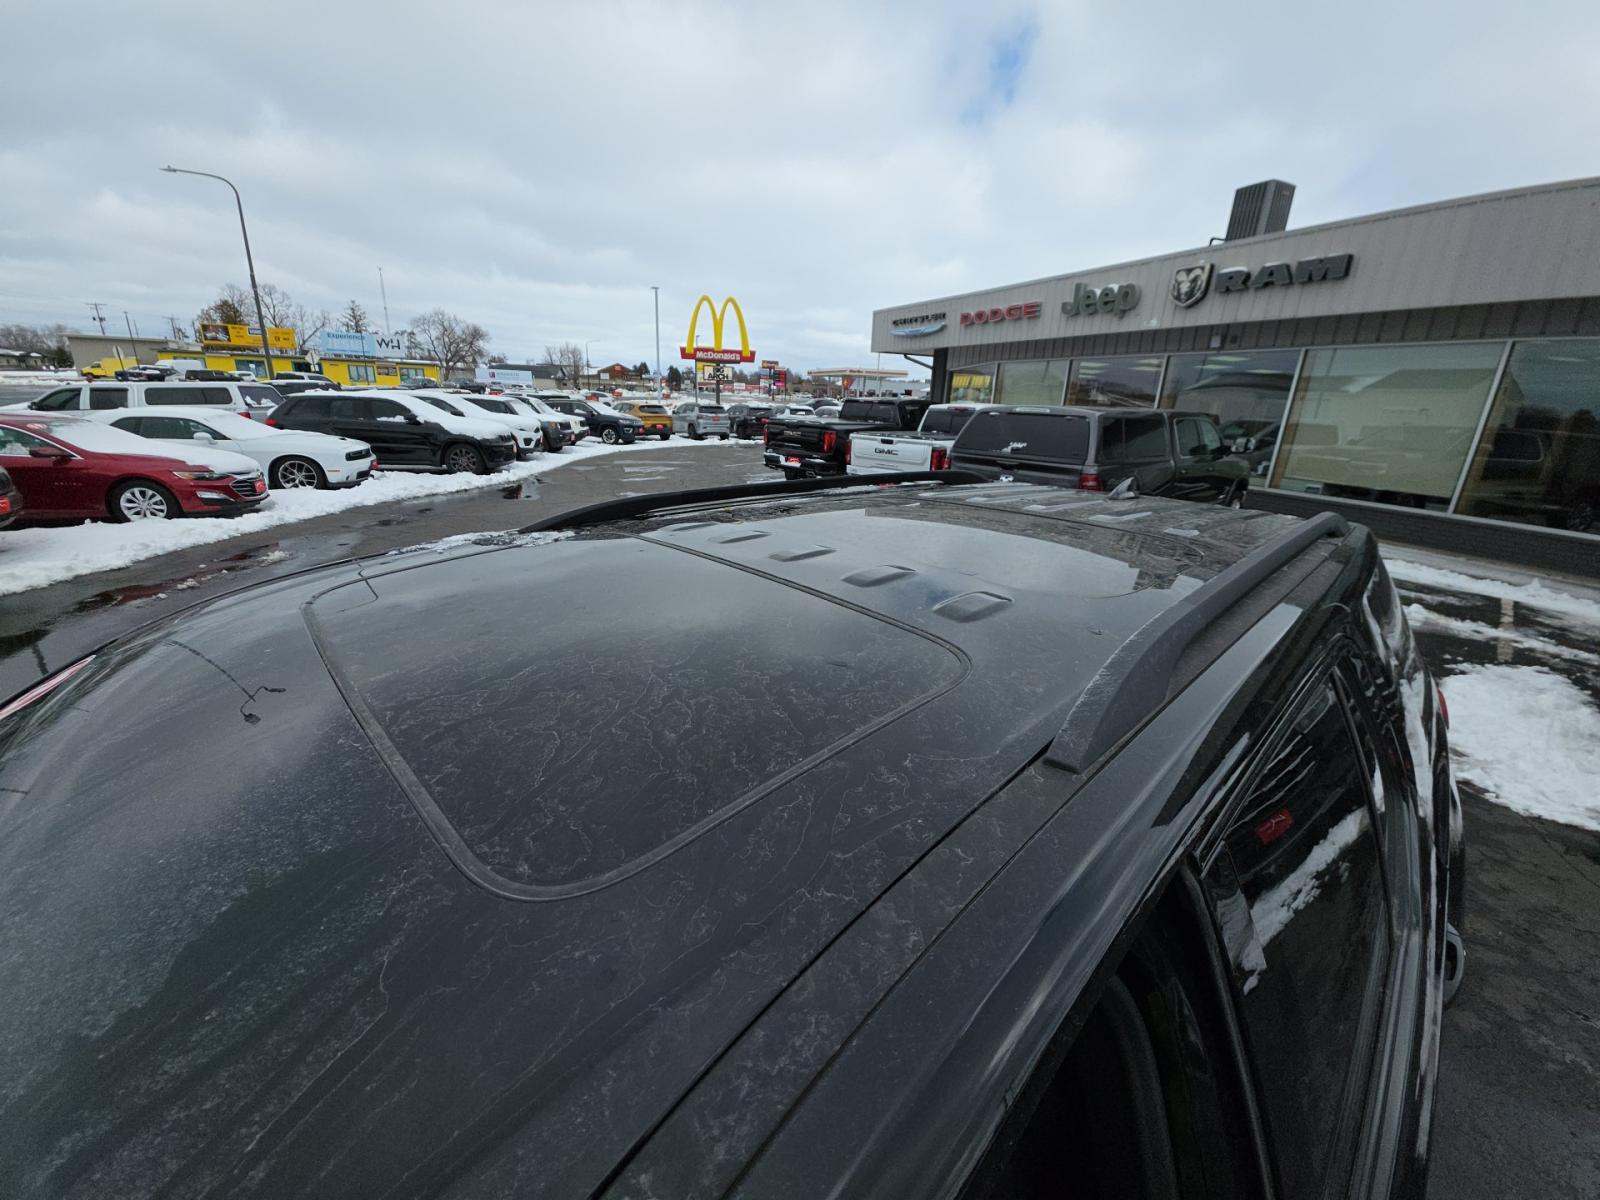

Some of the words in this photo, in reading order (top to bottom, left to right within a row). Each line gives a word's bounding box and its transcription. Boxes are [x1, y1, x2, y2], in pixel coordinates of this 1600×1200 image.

[1215, 254, 1353, 292] RAM
[1061, 282, 1142, 319] Jeep
[960, 301, 1041, 327] DODGE
[696, 351, 740, 360] McDonald's
[708, 373, 729, 381] ARCH
[874, 447, 899, 456] GMC
